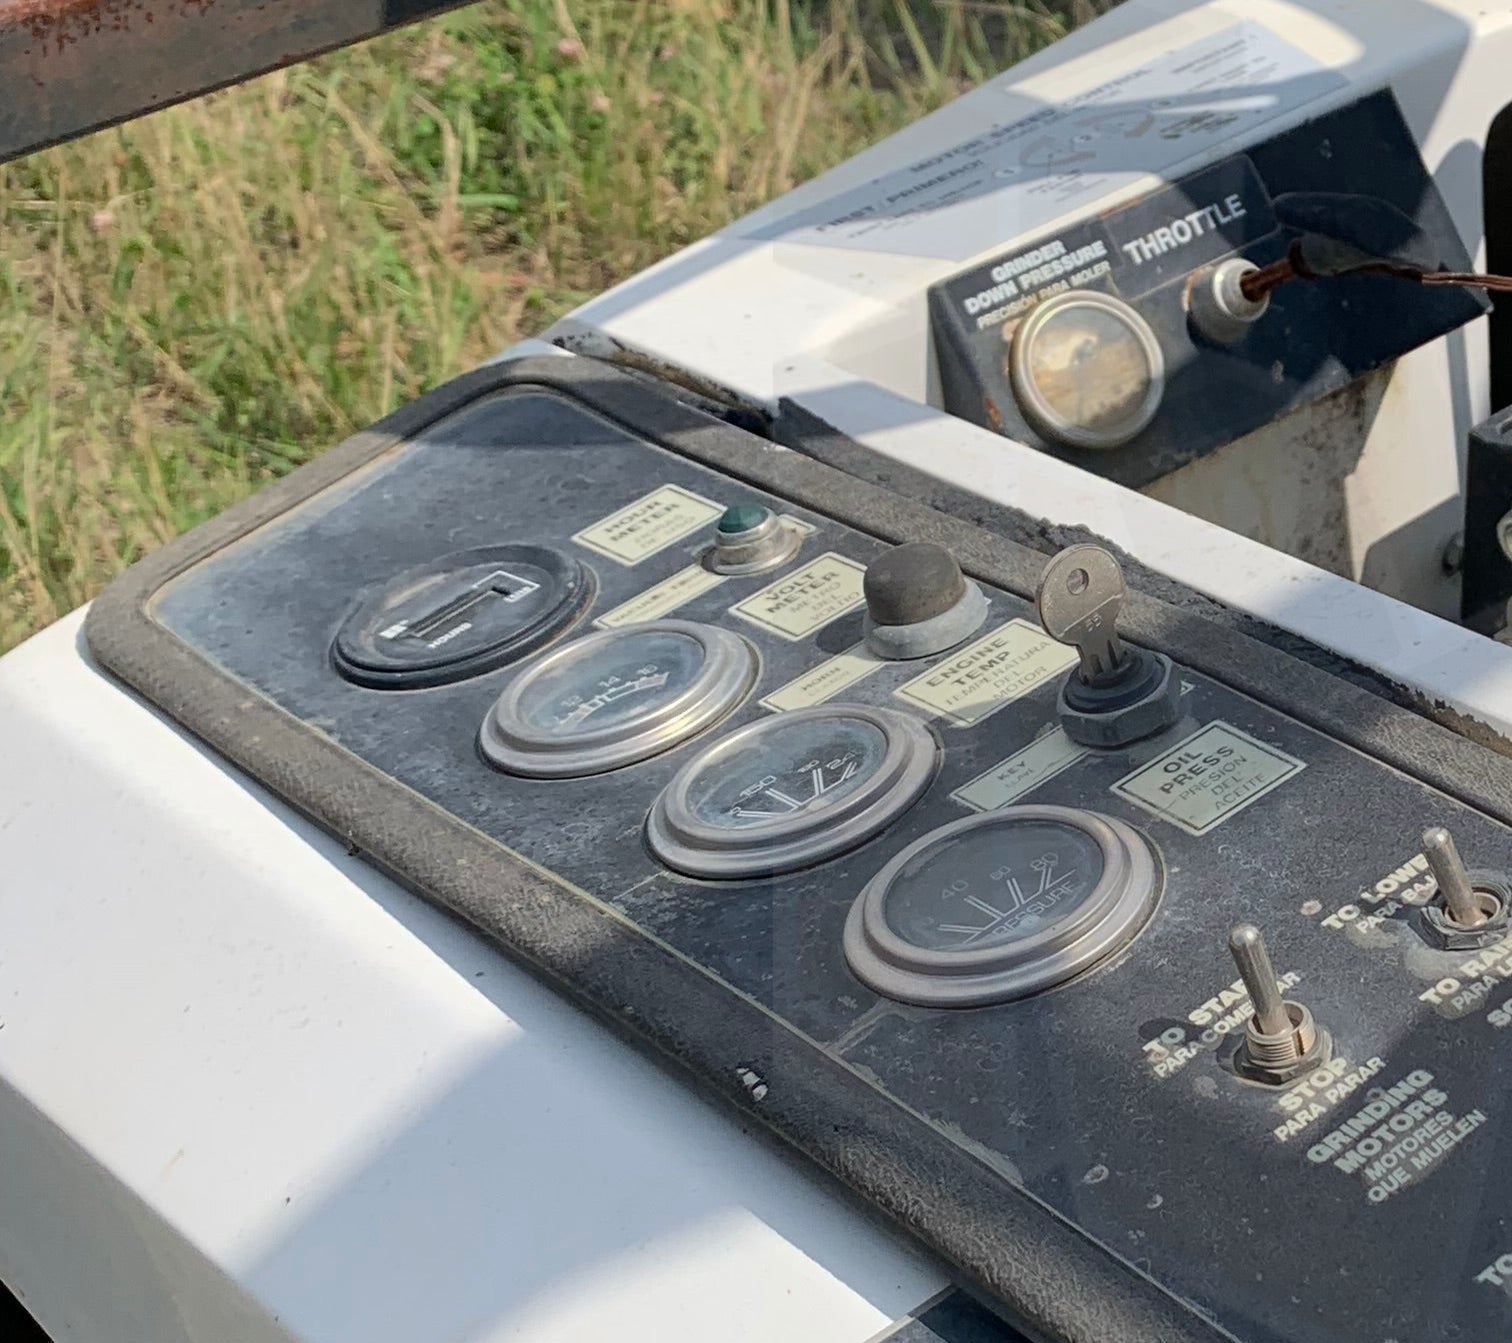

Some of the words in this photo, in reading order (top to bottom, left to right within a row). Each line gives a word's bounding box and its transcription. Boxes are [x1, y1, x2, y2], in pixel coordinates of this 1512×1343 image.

[909, 140, 985, 172] MOTOR
[990, 108, 1055, 139] SPEED
[1122, 193, 1247, 265] THROTTLE
[964, 279, 1019, 315] DOWN
[1018, 240, 1107, 291] PRESSURE
[991, 239, 1067, 282] GRINDER
[1069, 260, 1111, 288] MOLER
[604, 500, 661, 534] HOUR
[609, 503, 681, 542] METER
[765, 570, 817, 603] VOLT
[767, 570, 841, 615] METER
[800, 666, 841, 692] HORN
[925, 637, 1010, 688] ENGINE
[952, 649, 1011, 687] TEMP
[993, 666, 1022, 689] DEL
[991, 665, 1048, 702] MOTOR
[997, 759, 1027, 781] KEY
[1159, 745, 1235, 794] PRESS
[1163, 748, 1203, 773] OIL
[1214, 772, 1266, 811] ACEITE
[1320, 903, 1360, 930] TO
[1360, 852, 1430, 904] LOWE
[1355, 900, 1403, 934] PARA
[1418, 977, 1461, 1006] TO
[1451, 975, 1499, 1011] PARA
[1142, 1027, 1186, 1062] TO
[1154, 1040, 1205, 1078] PARA
[1273, 1103, 1327, 1143] PARA
[1326, 1055, 1388, 1104] PARAR
[1277, 1057, 1349, 1112] STOP
[1306, 1069, 1435, 1163] GRINDING
[1334, 1087, 1449, 1175] MOTORS
[1363, 1110, 1454, 1182] MOTORES
[1367, 1167, 1412, 1203] QUE
[1410, 1108, 1489, 1172] MUELEN
